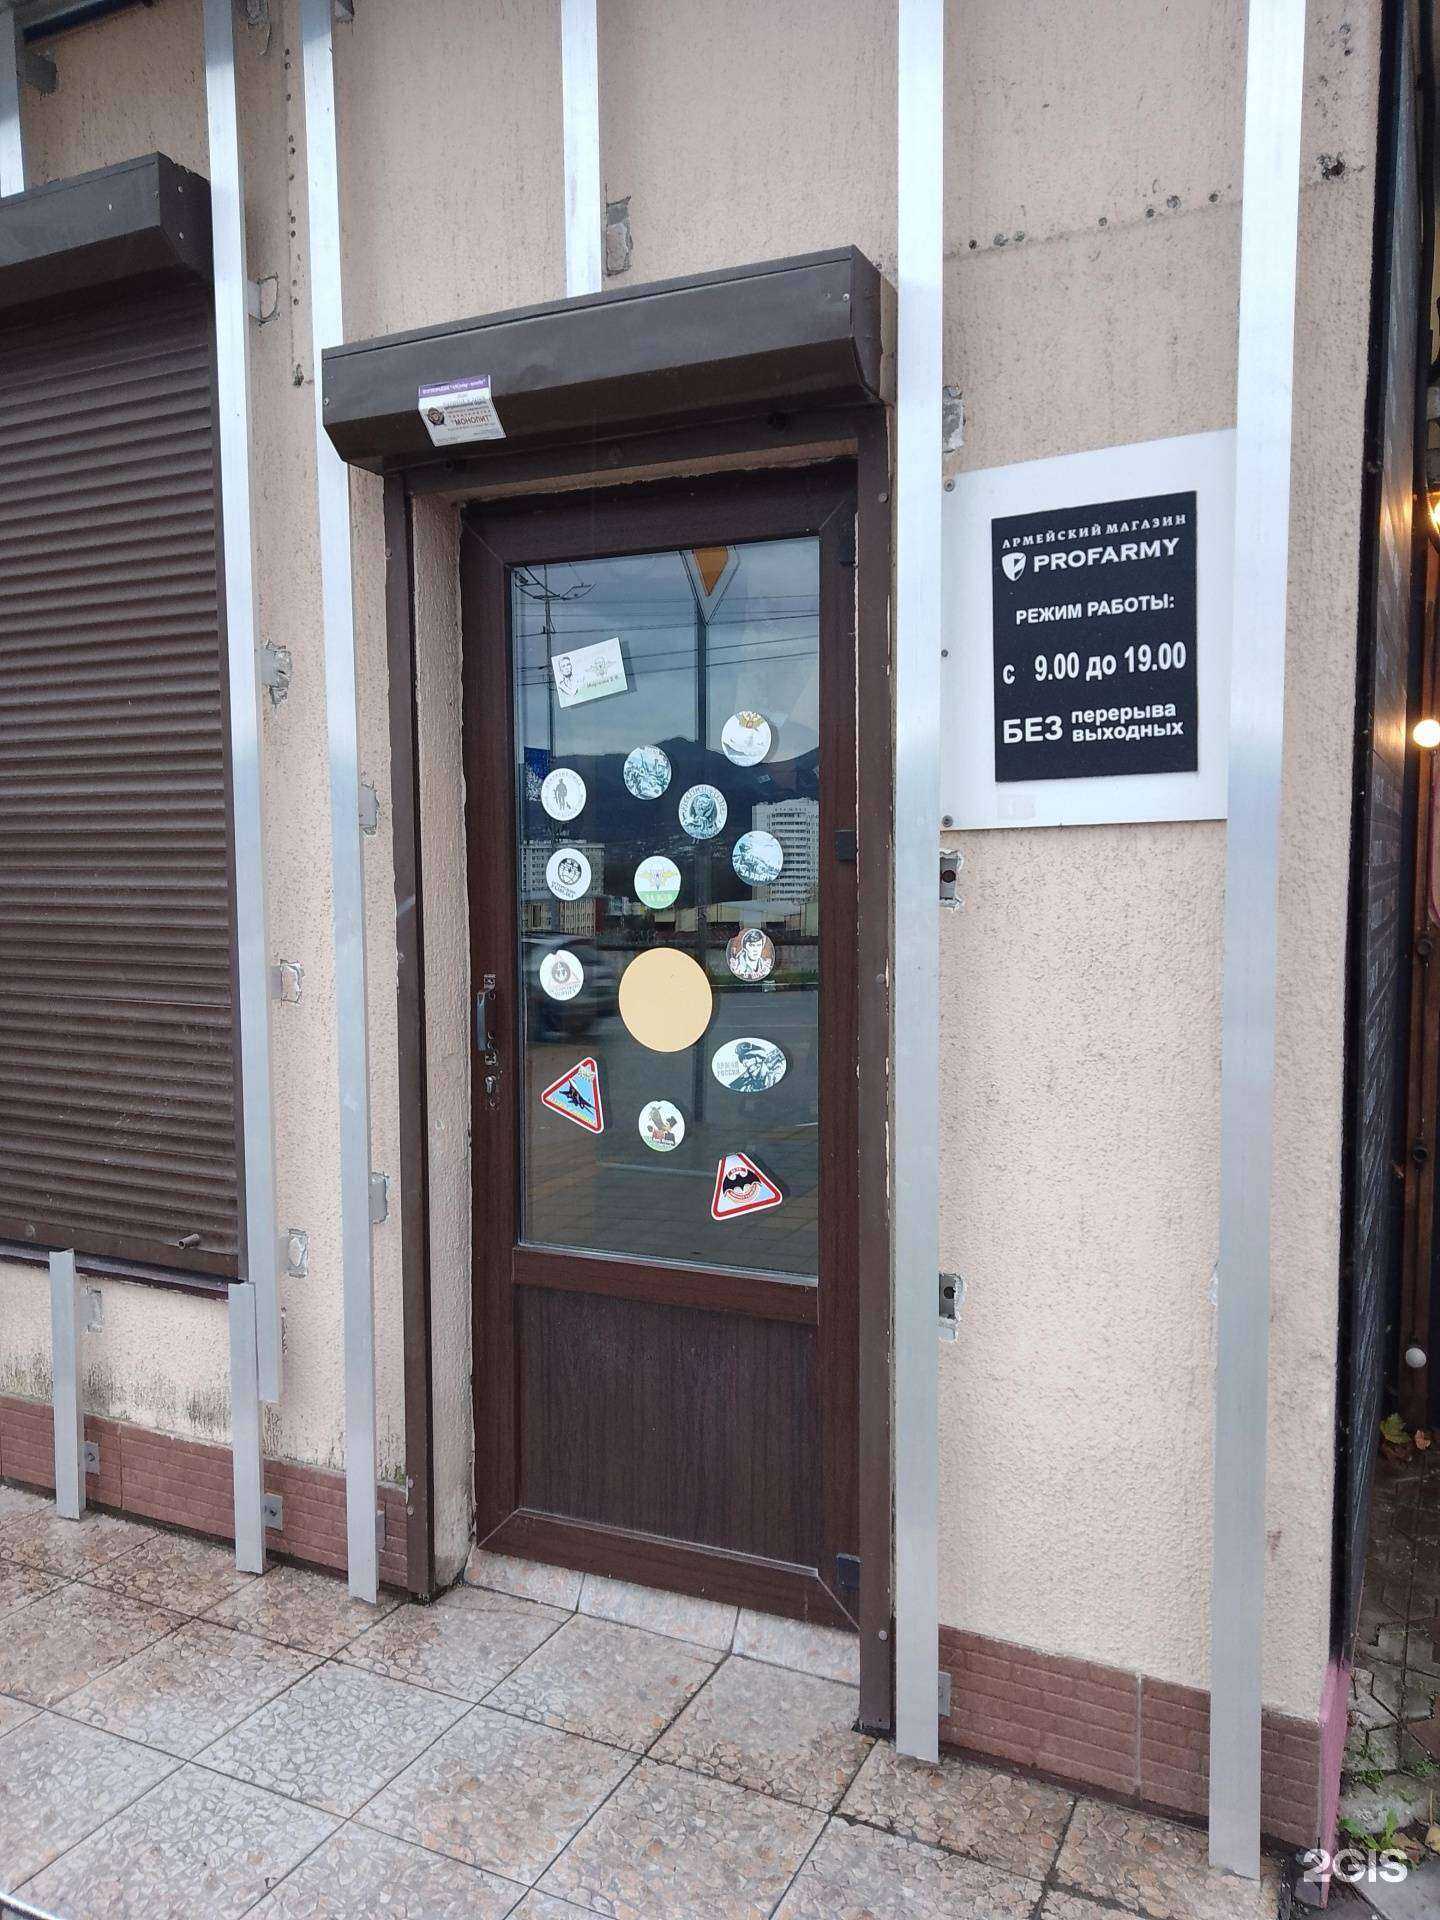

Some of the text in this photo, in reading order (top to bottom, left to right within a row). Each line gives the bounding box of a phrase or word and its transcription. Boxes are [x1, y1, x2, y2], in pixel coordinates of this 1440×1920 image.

[1002, 514, 1186, 549] АРМЕЙСКИЙ МАГАЗИН
[1033, 537, 1180, 573] PROFARMY
[1015, 593, 1175, 625] РЕЖИМ РАБОТЫ:
[1034, 651, 1080, 682] 9.00
[1085, 654, 1117, 682] до
[1124, 641, 1187, 673] 19.00
[1003, 703, 1177, 744] БЕЗ перерыва
[1072, 721, 1184, 743] выходных
